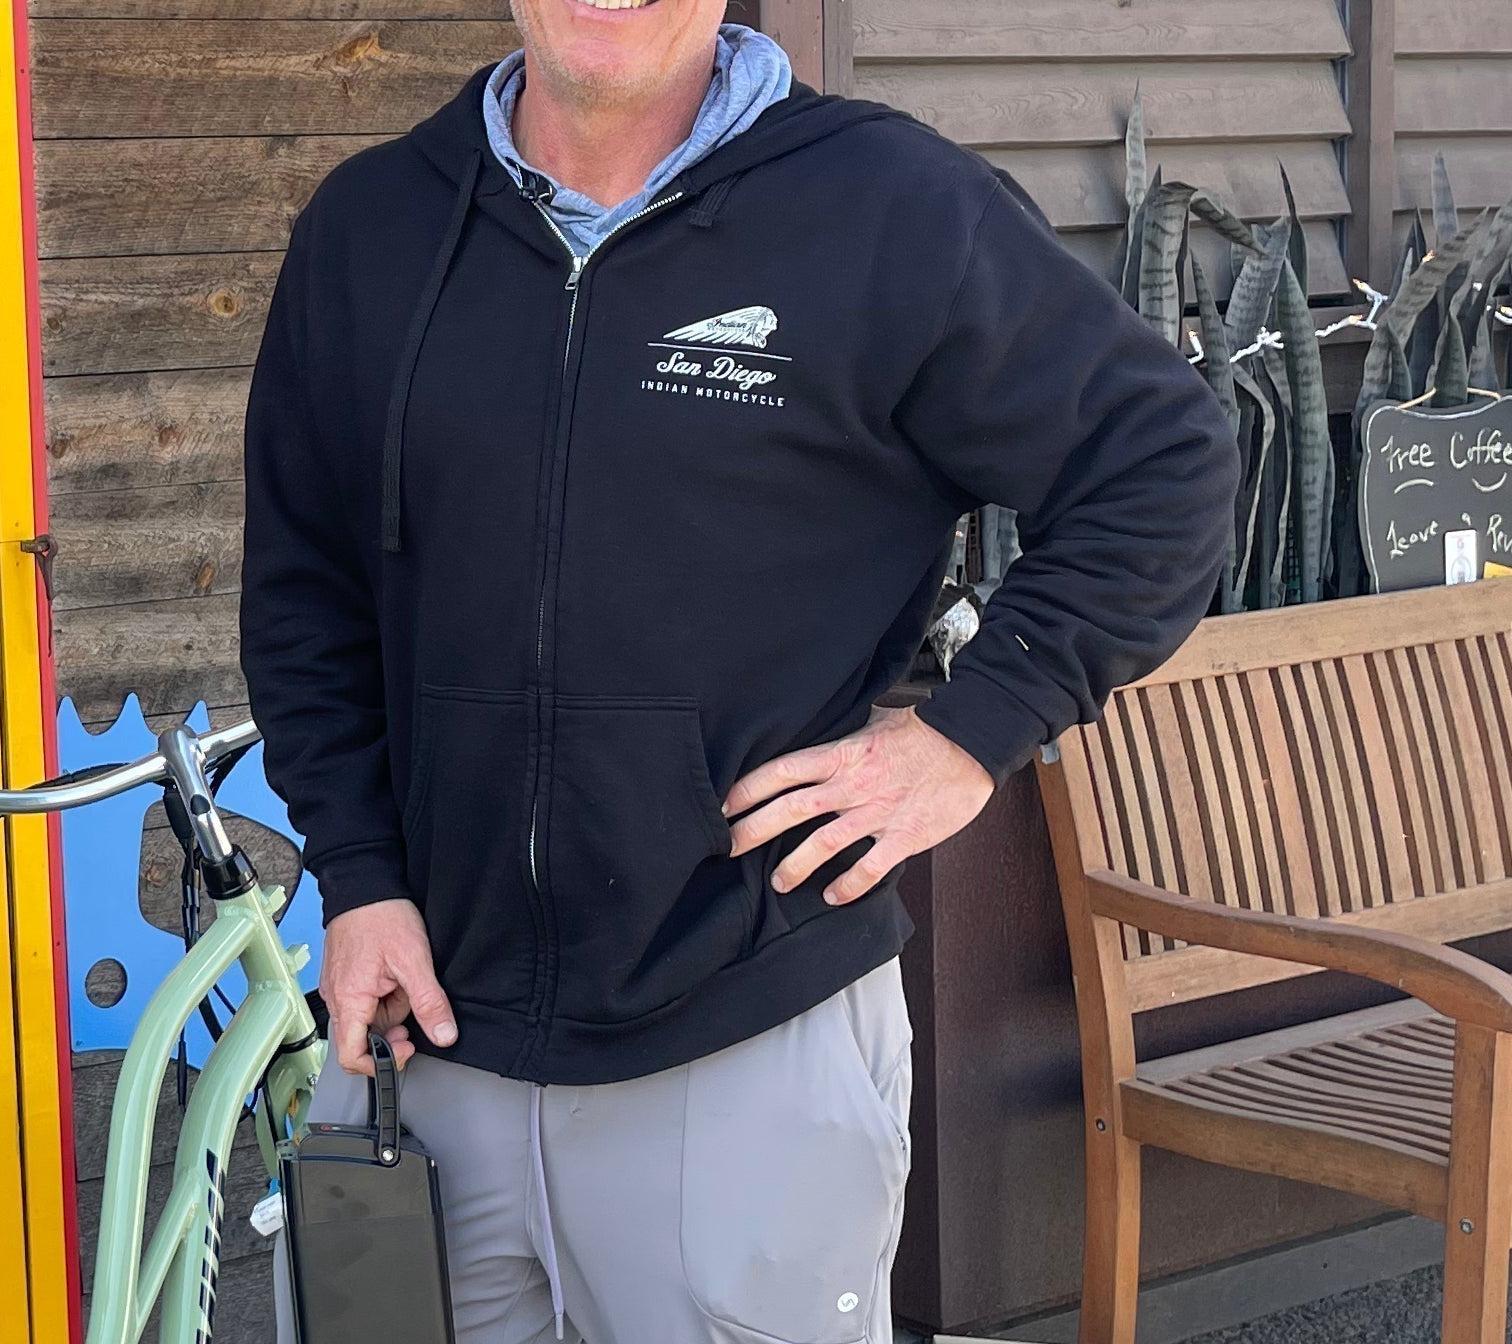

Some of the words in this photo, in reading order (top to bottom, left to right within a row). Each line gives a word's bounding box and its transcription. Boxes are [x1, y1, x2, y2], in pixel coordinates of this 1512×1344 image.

[656, 351, 702, 375] San
[705, 356, 777, 390] Diego
[641, 380, 688, 394] INDIAN
[695, 386, 785, 407] MOTORCYCLE
